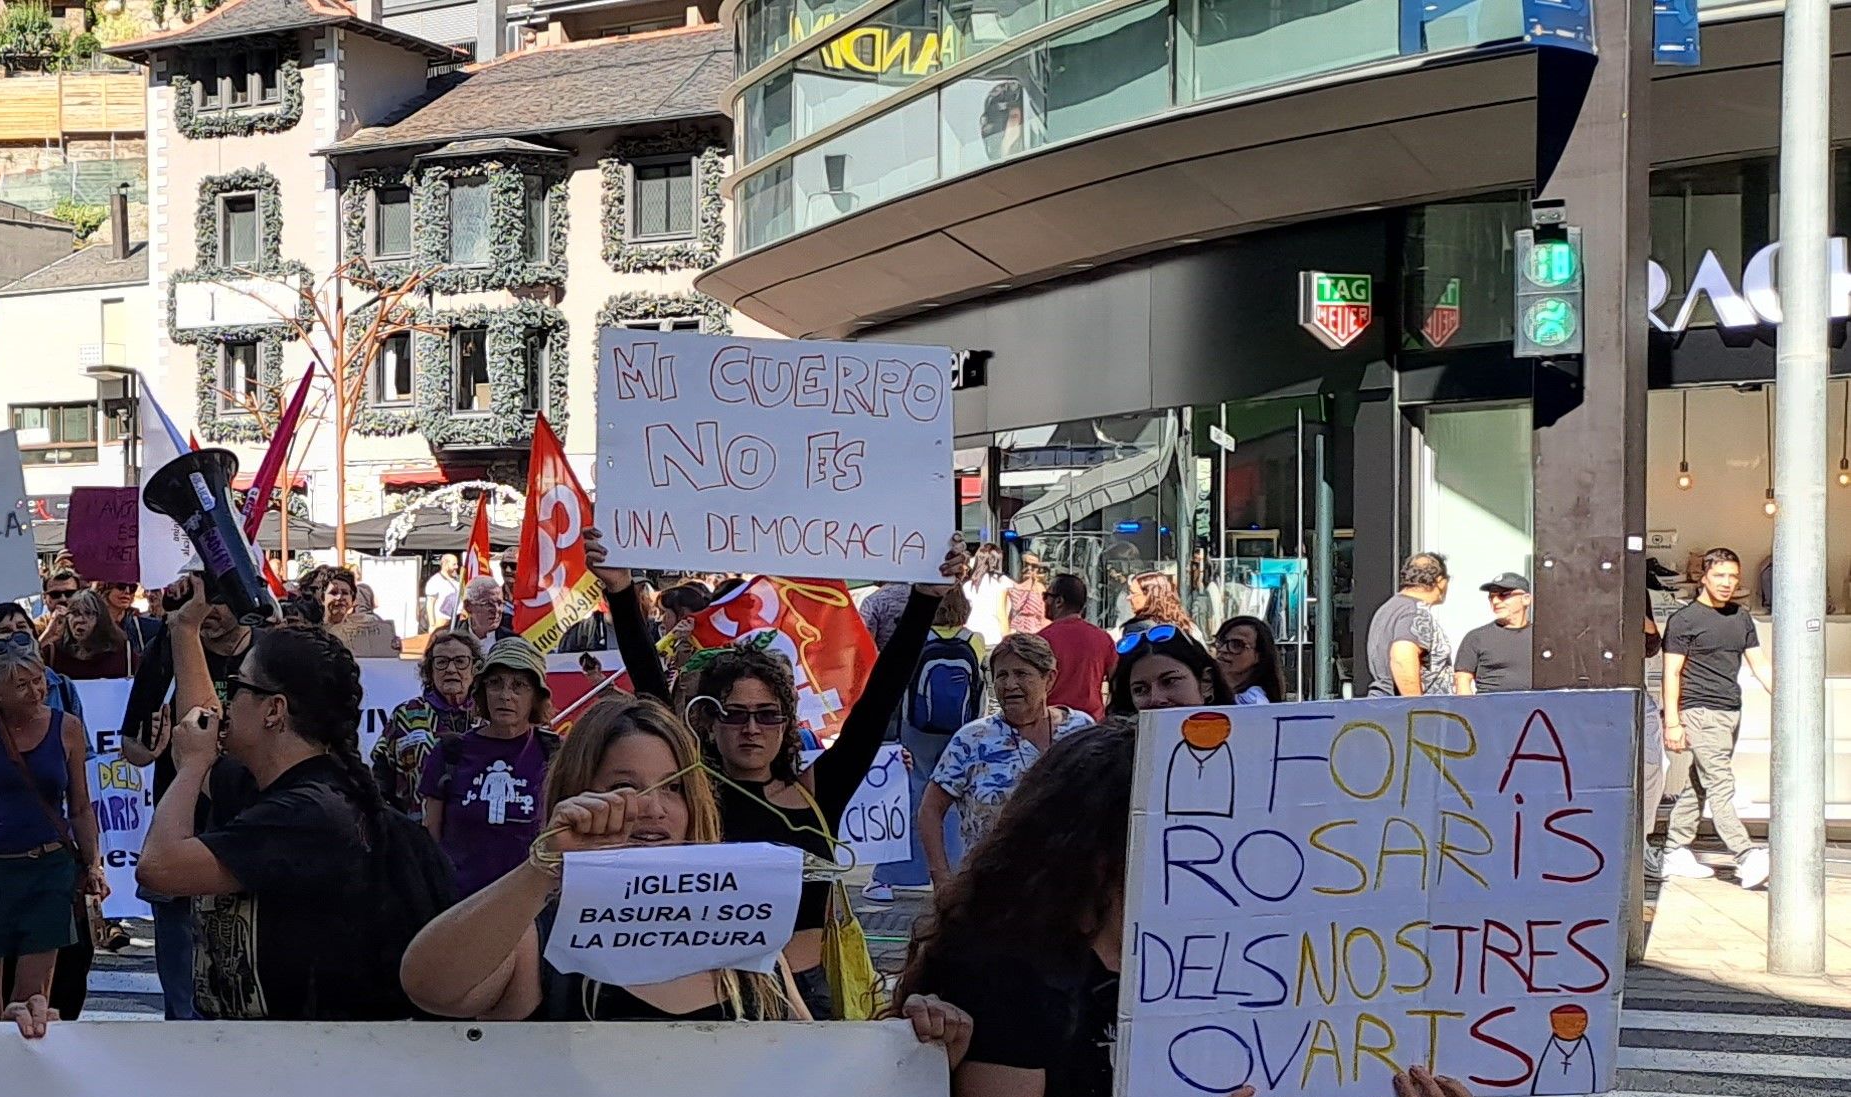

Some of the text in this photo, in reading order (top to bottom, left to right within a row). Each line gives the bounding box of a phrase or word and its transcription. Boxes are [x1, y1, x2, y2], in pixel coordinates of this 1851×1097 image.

[1318, 279, 1367, 300] TAG
[614, 341, 943, 422] MI CUERPO
[645, 420, 865, 491] NO ES
[615, 509, 926, 561] UNA DEMOCRACIA
[623, 871, 740, 901] ¡IGLESIA
[579, 904, 693, 925] BASURA
[717, 901, 773, 922] SOS
[569, 928, 768, 951] LA DICTADURA
